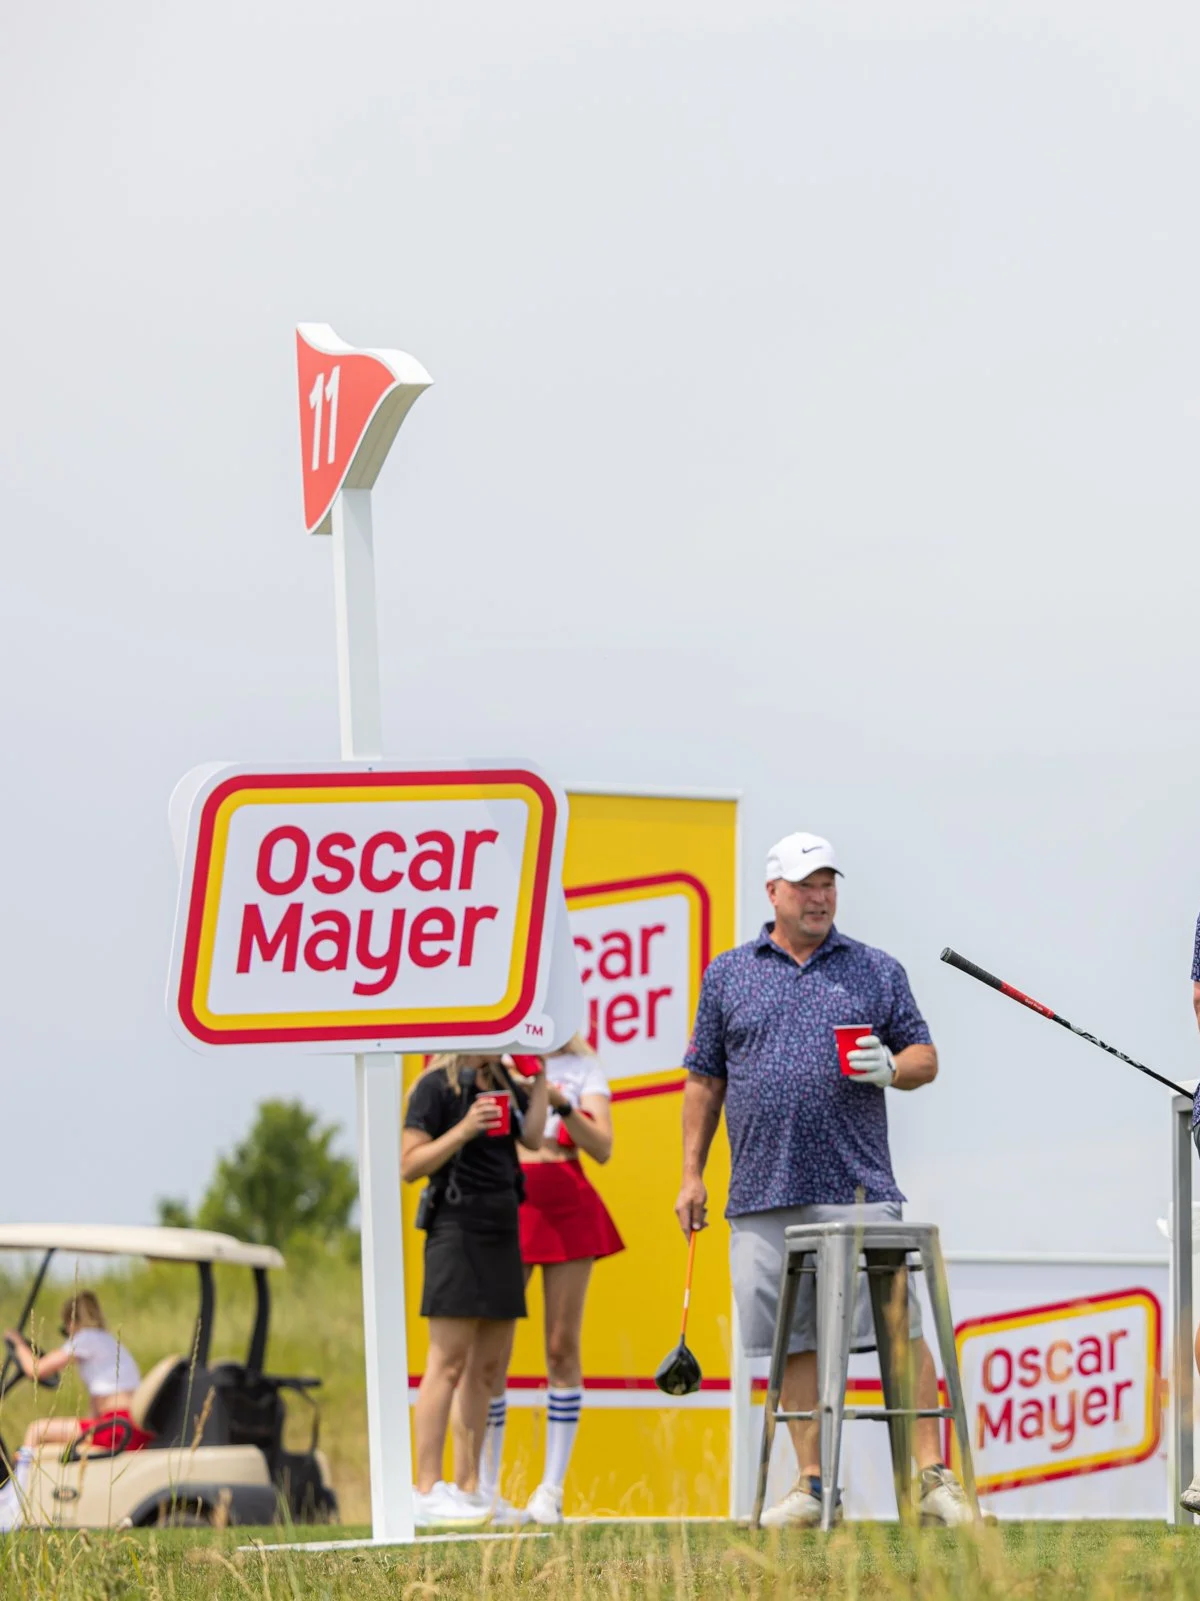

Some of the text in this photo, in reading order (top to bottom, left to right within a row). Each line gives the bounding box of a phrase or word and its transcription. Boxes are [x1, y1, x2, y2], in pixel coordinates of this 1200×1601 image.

[308, 365, 341, 471] 11
[256, 825, 499, 895] Oscar
[236, 903, 499, 996] Mayer
[525, 1023, 543, 1036] TM
[982, 1329, 1128, 1395] Oscar
[976, 1379, 1133, 1452] Mayer
